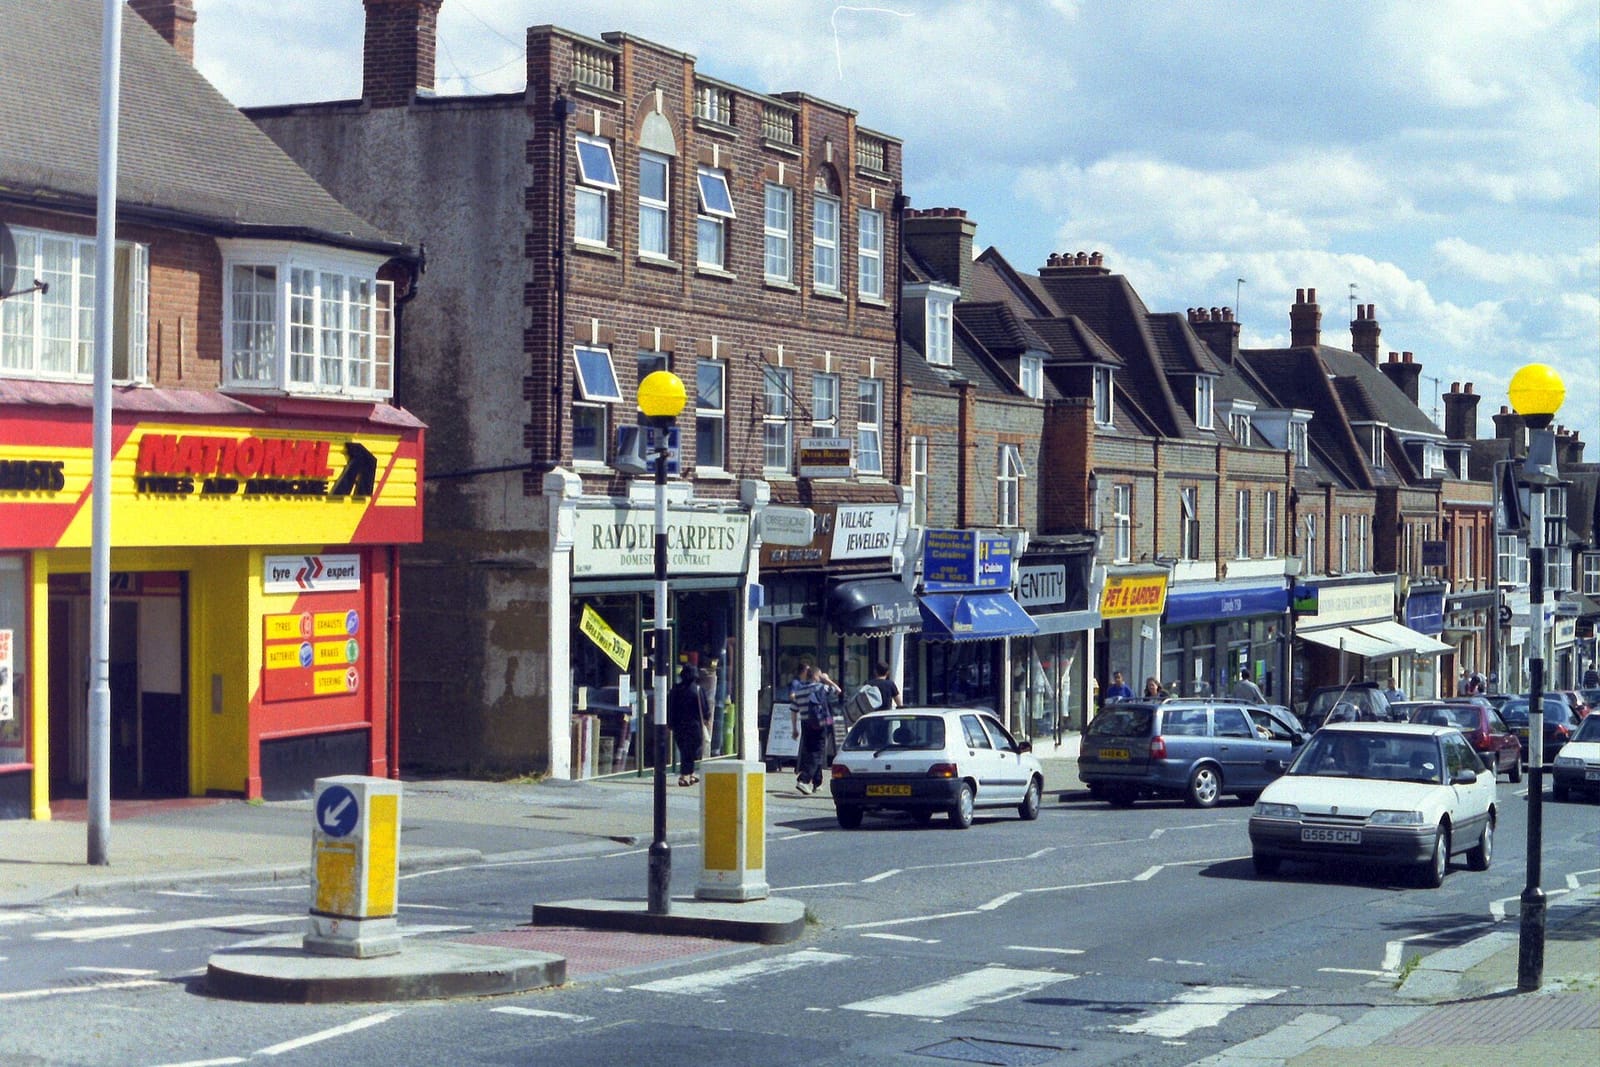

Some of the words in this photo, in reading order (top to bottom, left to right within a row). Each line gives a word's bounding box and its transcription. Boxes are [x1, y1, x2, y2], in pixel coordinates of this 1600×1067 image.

[137, 433, 334, 477] NATIONAL
[840, 511, 874, 529] VILLAGE
[666, 524, 734, 550] CARPETS
[846, 532, 890, 554] JEWELLERS
[673, 554, 711, 566] CONTRACT
[932, 550, 967, 559] Cuisine
[272, 566, 291, 582] tyre
[327, 564, 355, 579] expert
[1020, 571, 1064, 600] ENTITY
[1104, 588, 1121, 607] PET
[1130, 585, 1161, 605] GARDEN
[275, 622, 291, 631] TYRES
[270, 651, 295, 661] BATTERIES
[320, 647, 339, 657] BRAKES
[318, 676, 342, 687] STEERING
[1303, 829, 1334, 841] G565
[1336, 831, 1360, 842] CHJ
